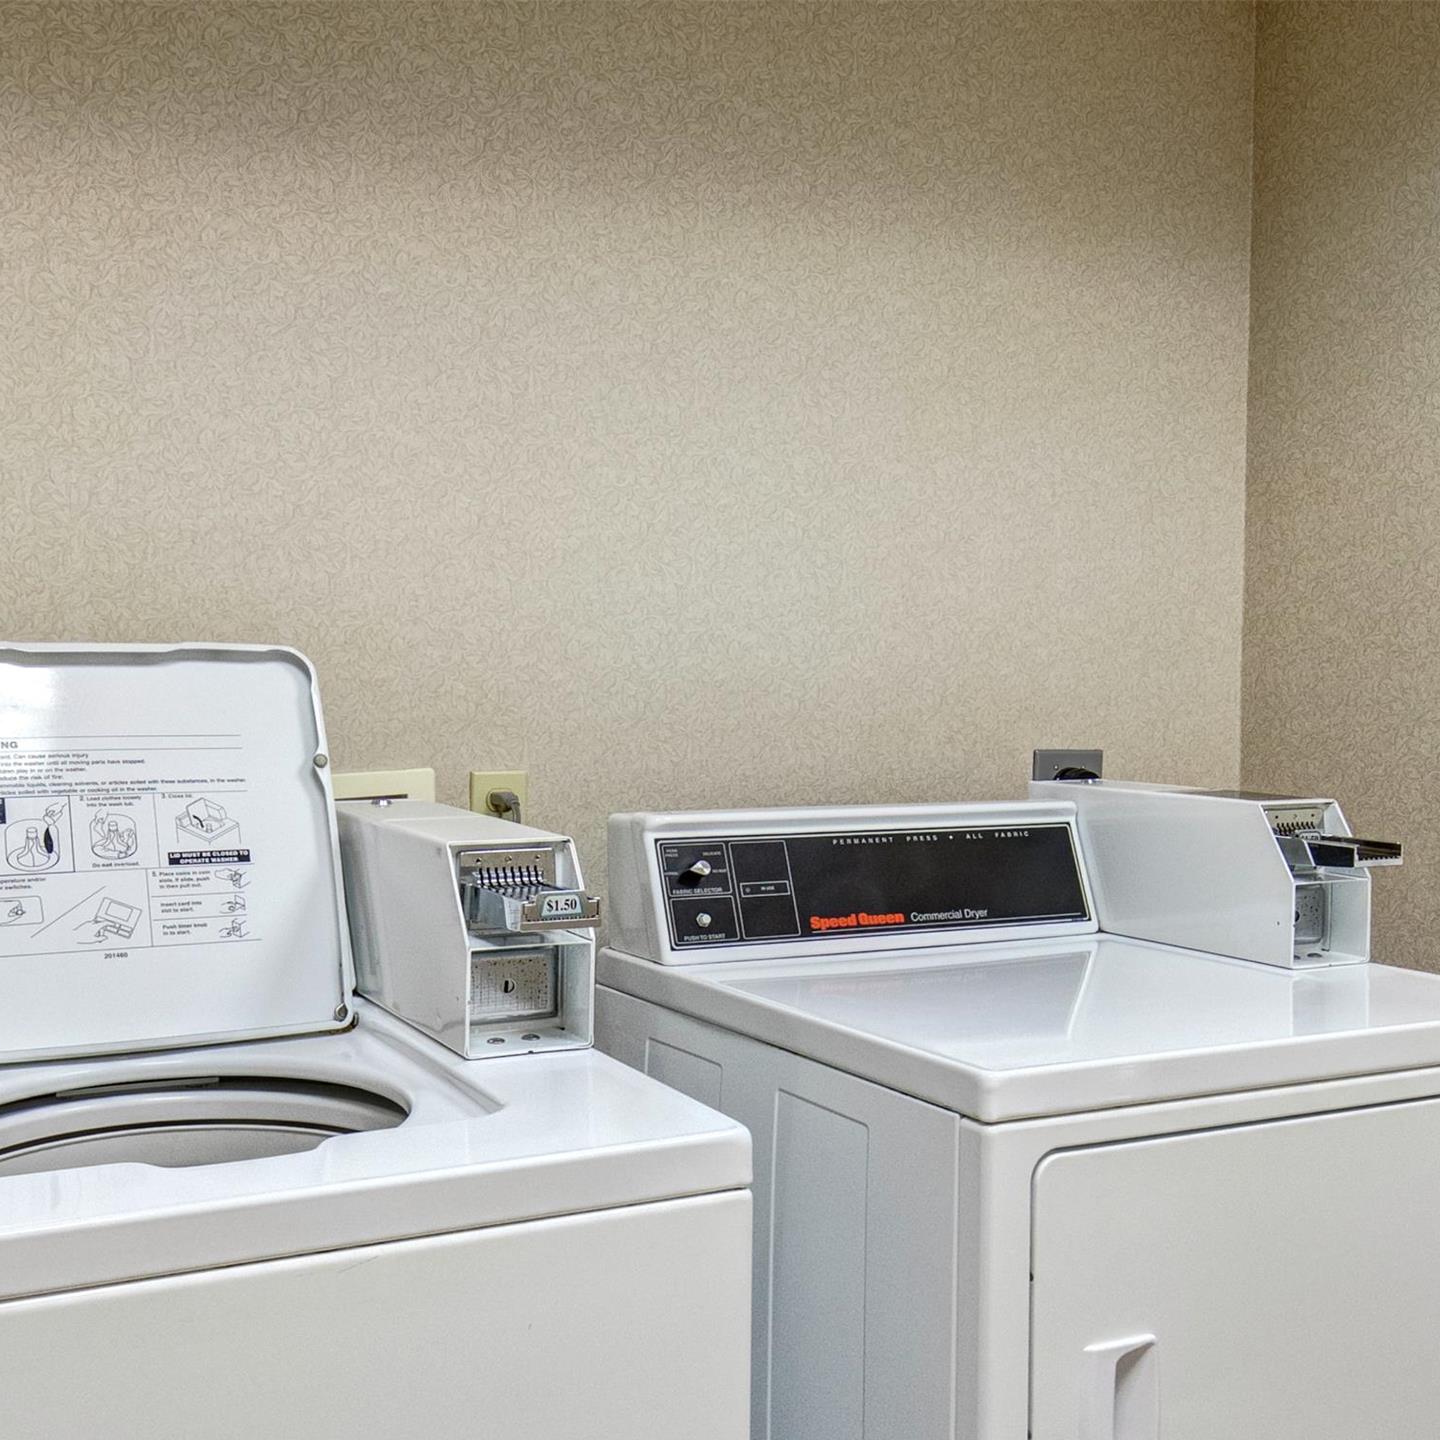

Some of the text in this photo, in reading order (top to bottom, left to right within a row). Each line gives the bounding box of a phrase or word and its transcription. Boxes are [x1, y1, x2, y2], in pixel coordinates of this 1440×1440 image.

[833, 836, 894, 845] PERMANENT
[546, 898, 577, 912] $1.50
[811, 912, 904, 930] Speed Queen
[910, 908, 988, 922] Commercial Dryer
